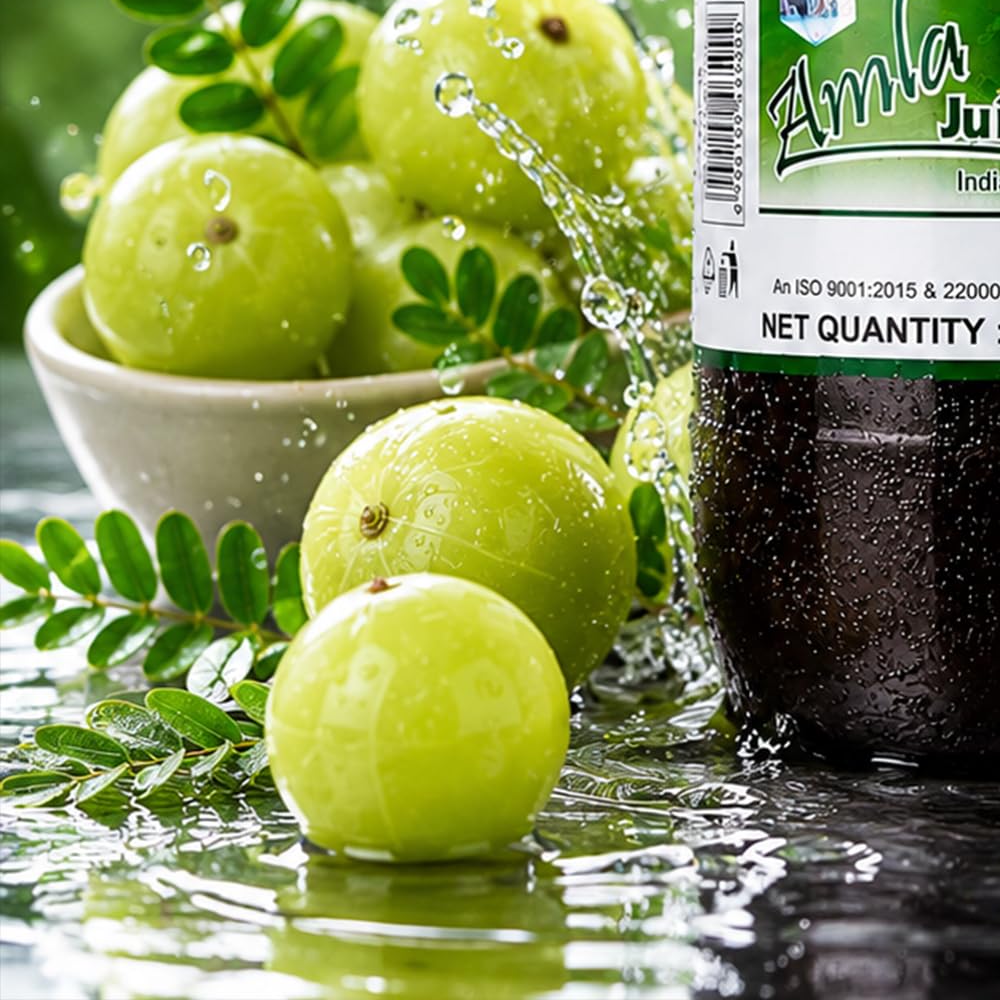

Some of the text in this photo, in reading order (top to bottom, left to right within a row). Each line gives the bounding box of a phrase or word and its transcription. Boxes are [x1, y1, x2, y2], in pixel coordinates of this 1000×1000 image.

[773, 278, 791, 295] An
[795, 279, 823, 297] ISO
[826, 280, 918, 299] 9001:2015
[923, 282, 937, 300] &
[762, 312, 810, 340] NET
[817, 314, 986, 345] QUANTITY
